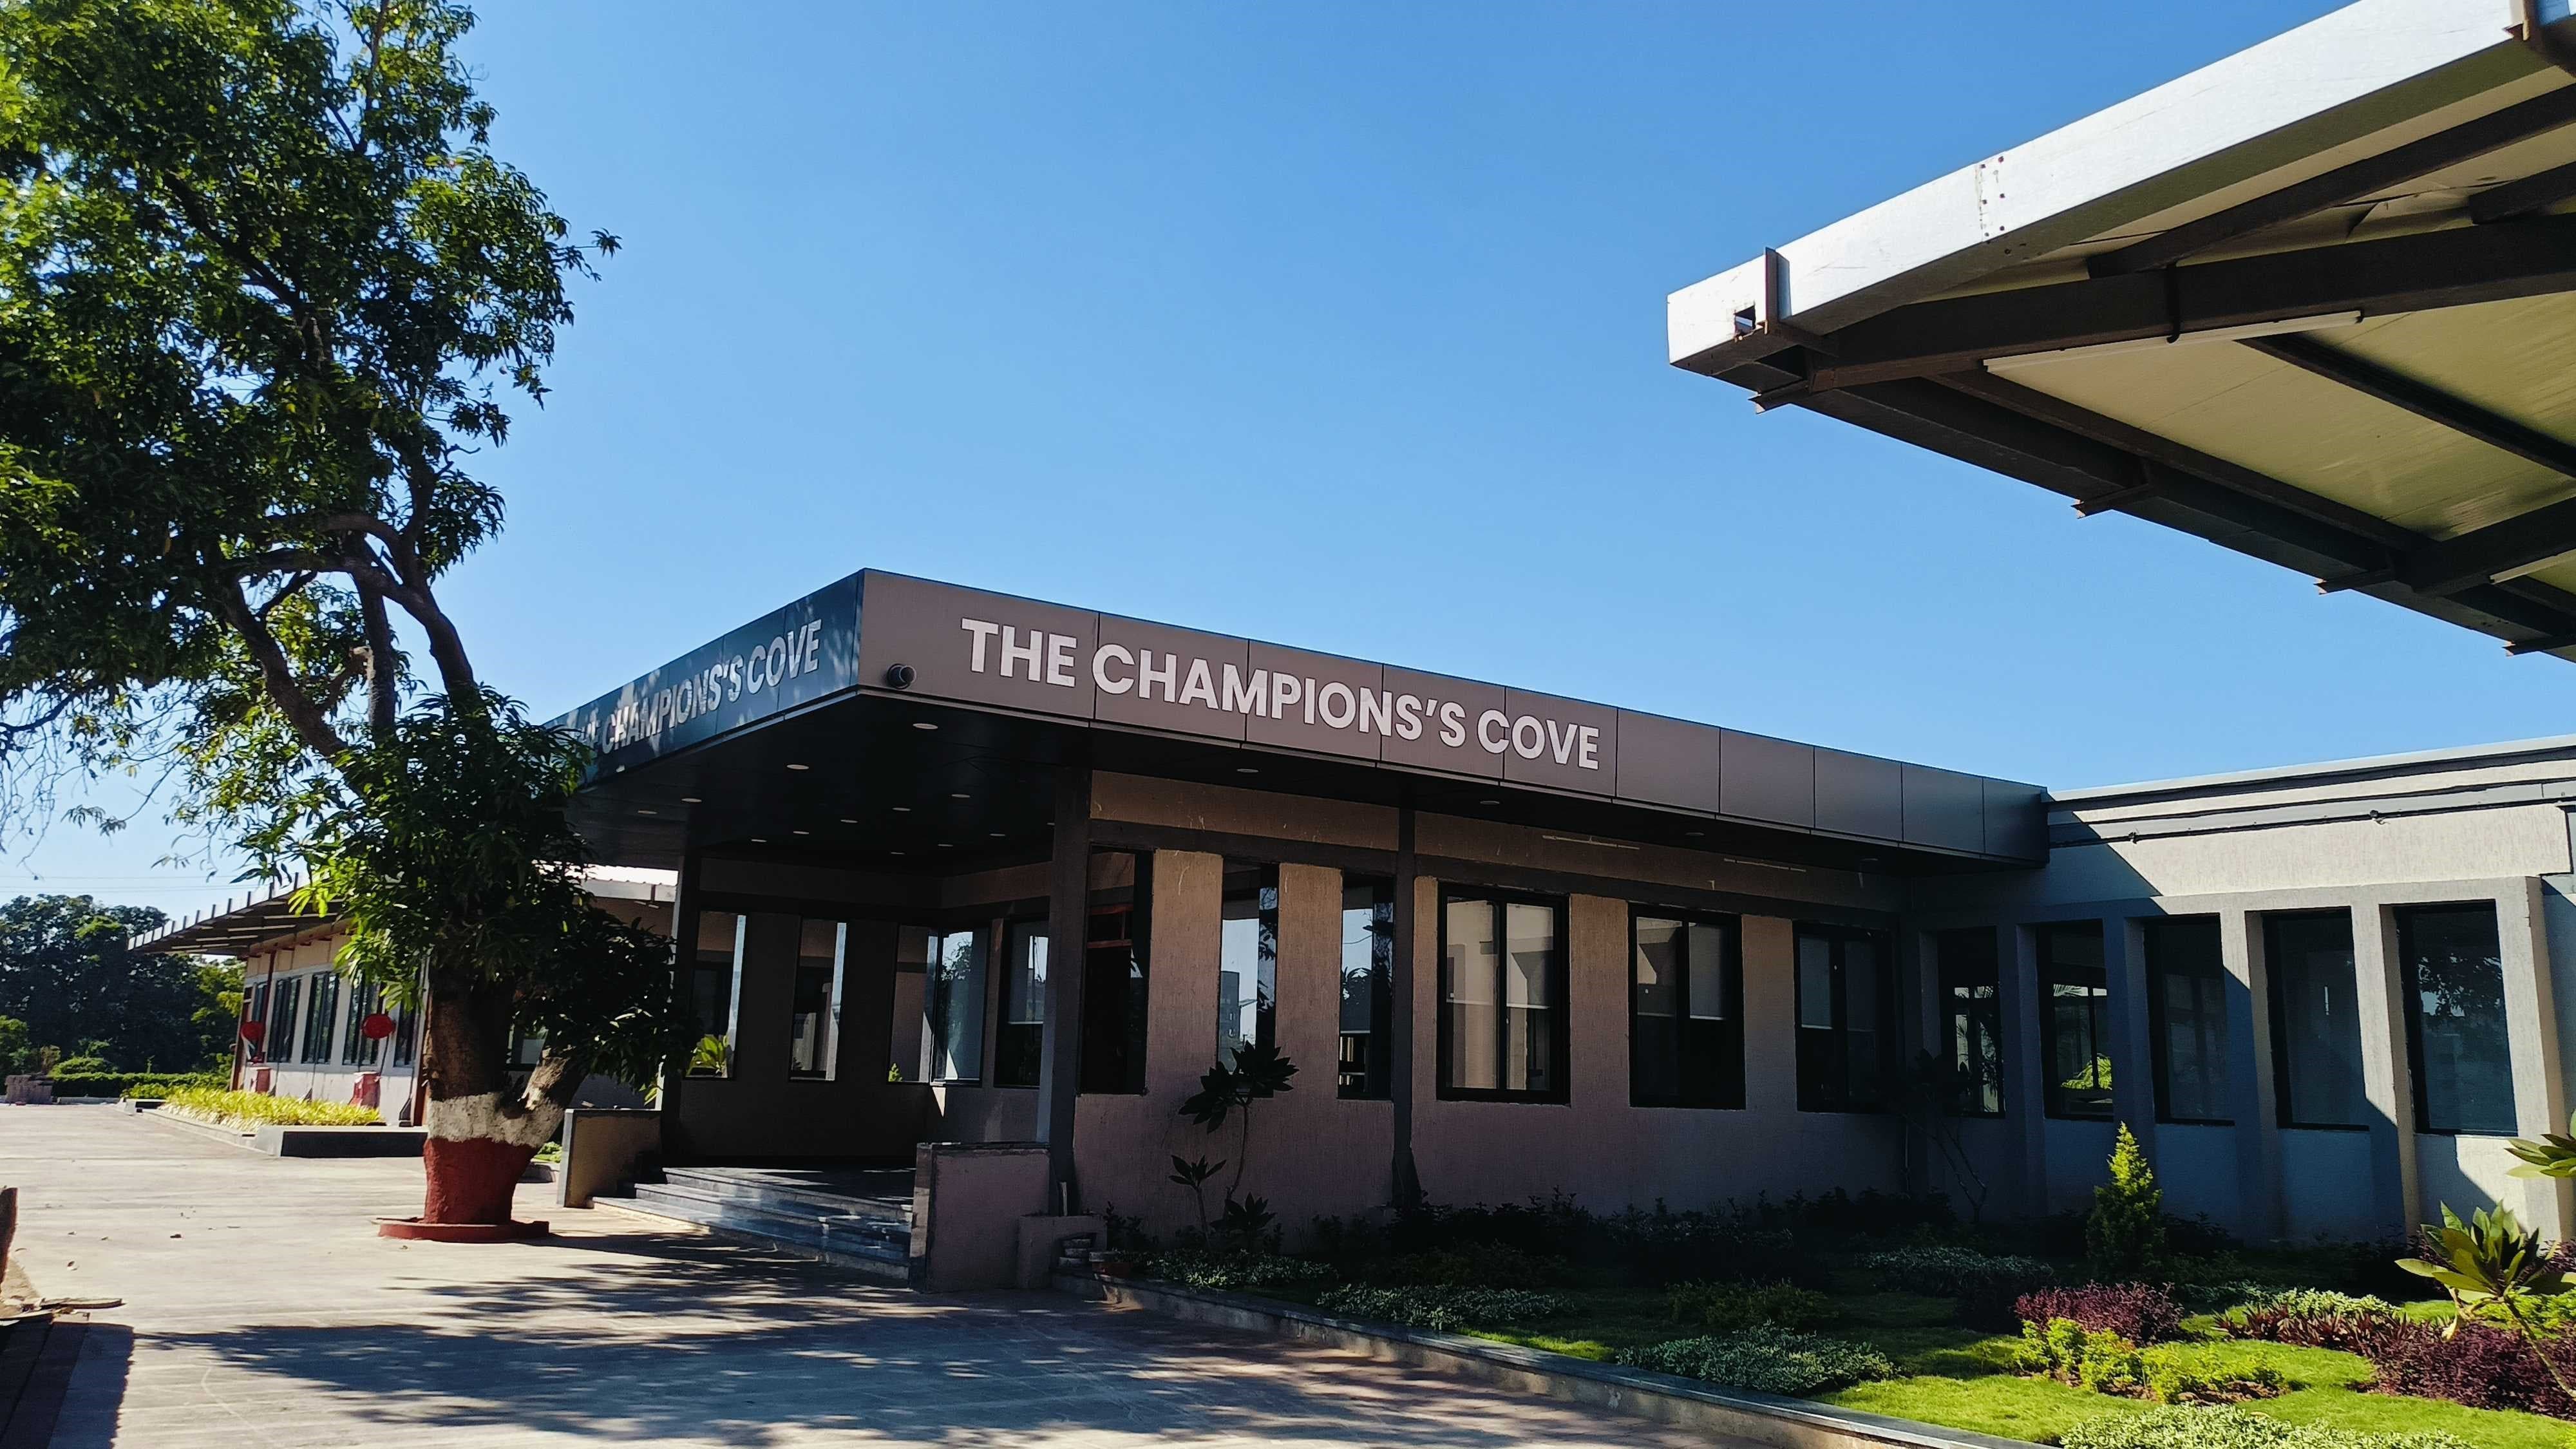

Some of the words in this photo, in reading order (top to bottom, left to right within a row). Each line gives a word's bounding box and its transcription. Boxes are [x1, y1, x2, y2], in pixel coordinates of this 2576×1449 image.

[602, 655, 743, 754] CHAMPIONS'S
[747, 619, 822, 694] COVE
[961, 618, 1077, 688] THE
[1092, 643, 1466, 748] CHAMPIONS'S
[1477, 708, 1600, 770] COVE
